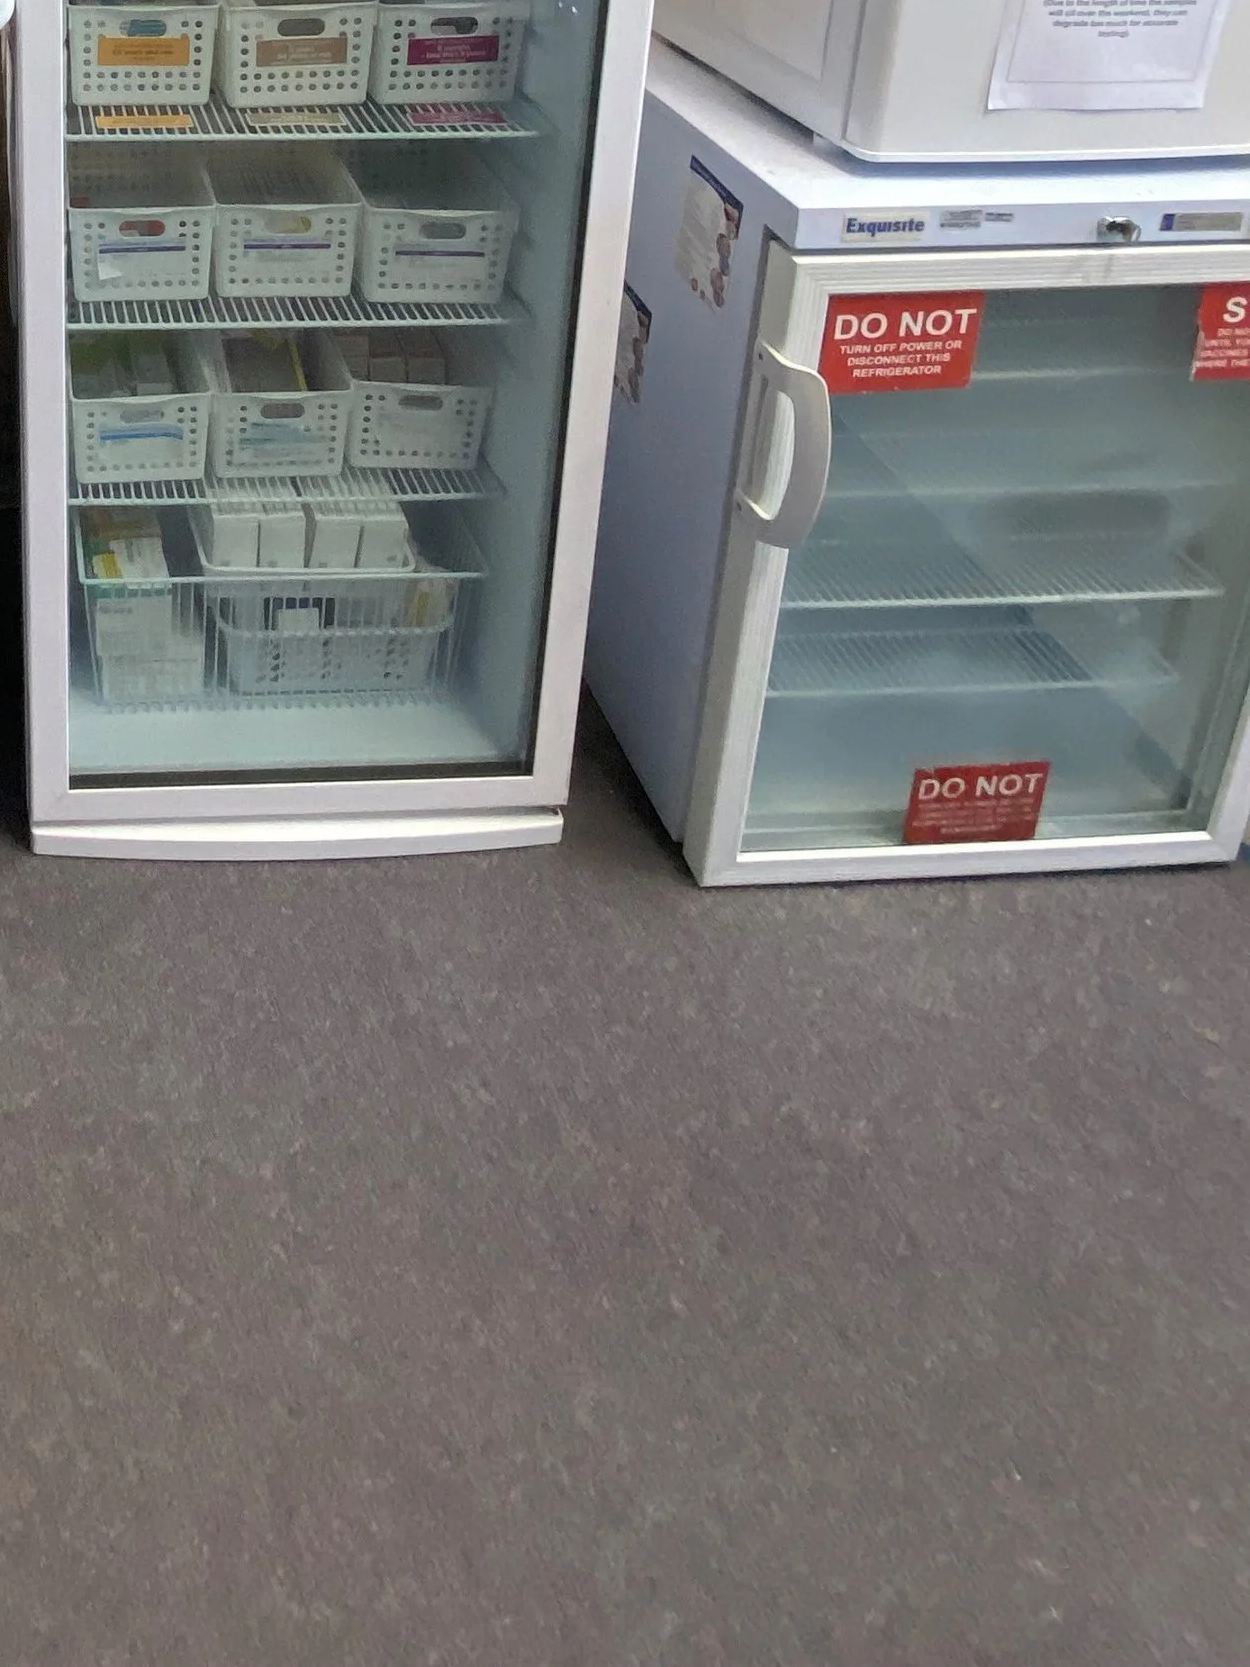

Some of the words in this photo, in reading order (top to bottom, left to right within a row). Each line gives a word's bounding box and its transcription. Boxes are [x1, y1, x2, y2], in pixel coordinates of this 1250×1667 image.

[845, 218, 926, 237] Exquisite
[834, 312, 888, 340] DO
[899, 308, 978, 337] NOT
[839, 344, 871, 354] TURN
[874, 343, 897, 353] OFF
[899, 341, 942, 352] POWER
[945, 340, 963, 349] OR
[847, 353, 921, 366] DISCONNECT
[926, 353, 951, 363] THIS
[852, 365, 942, 378] REFRIGERATOR
[918, 777, 966, 800] DO
[975, 773, 1043, 797] NOT
